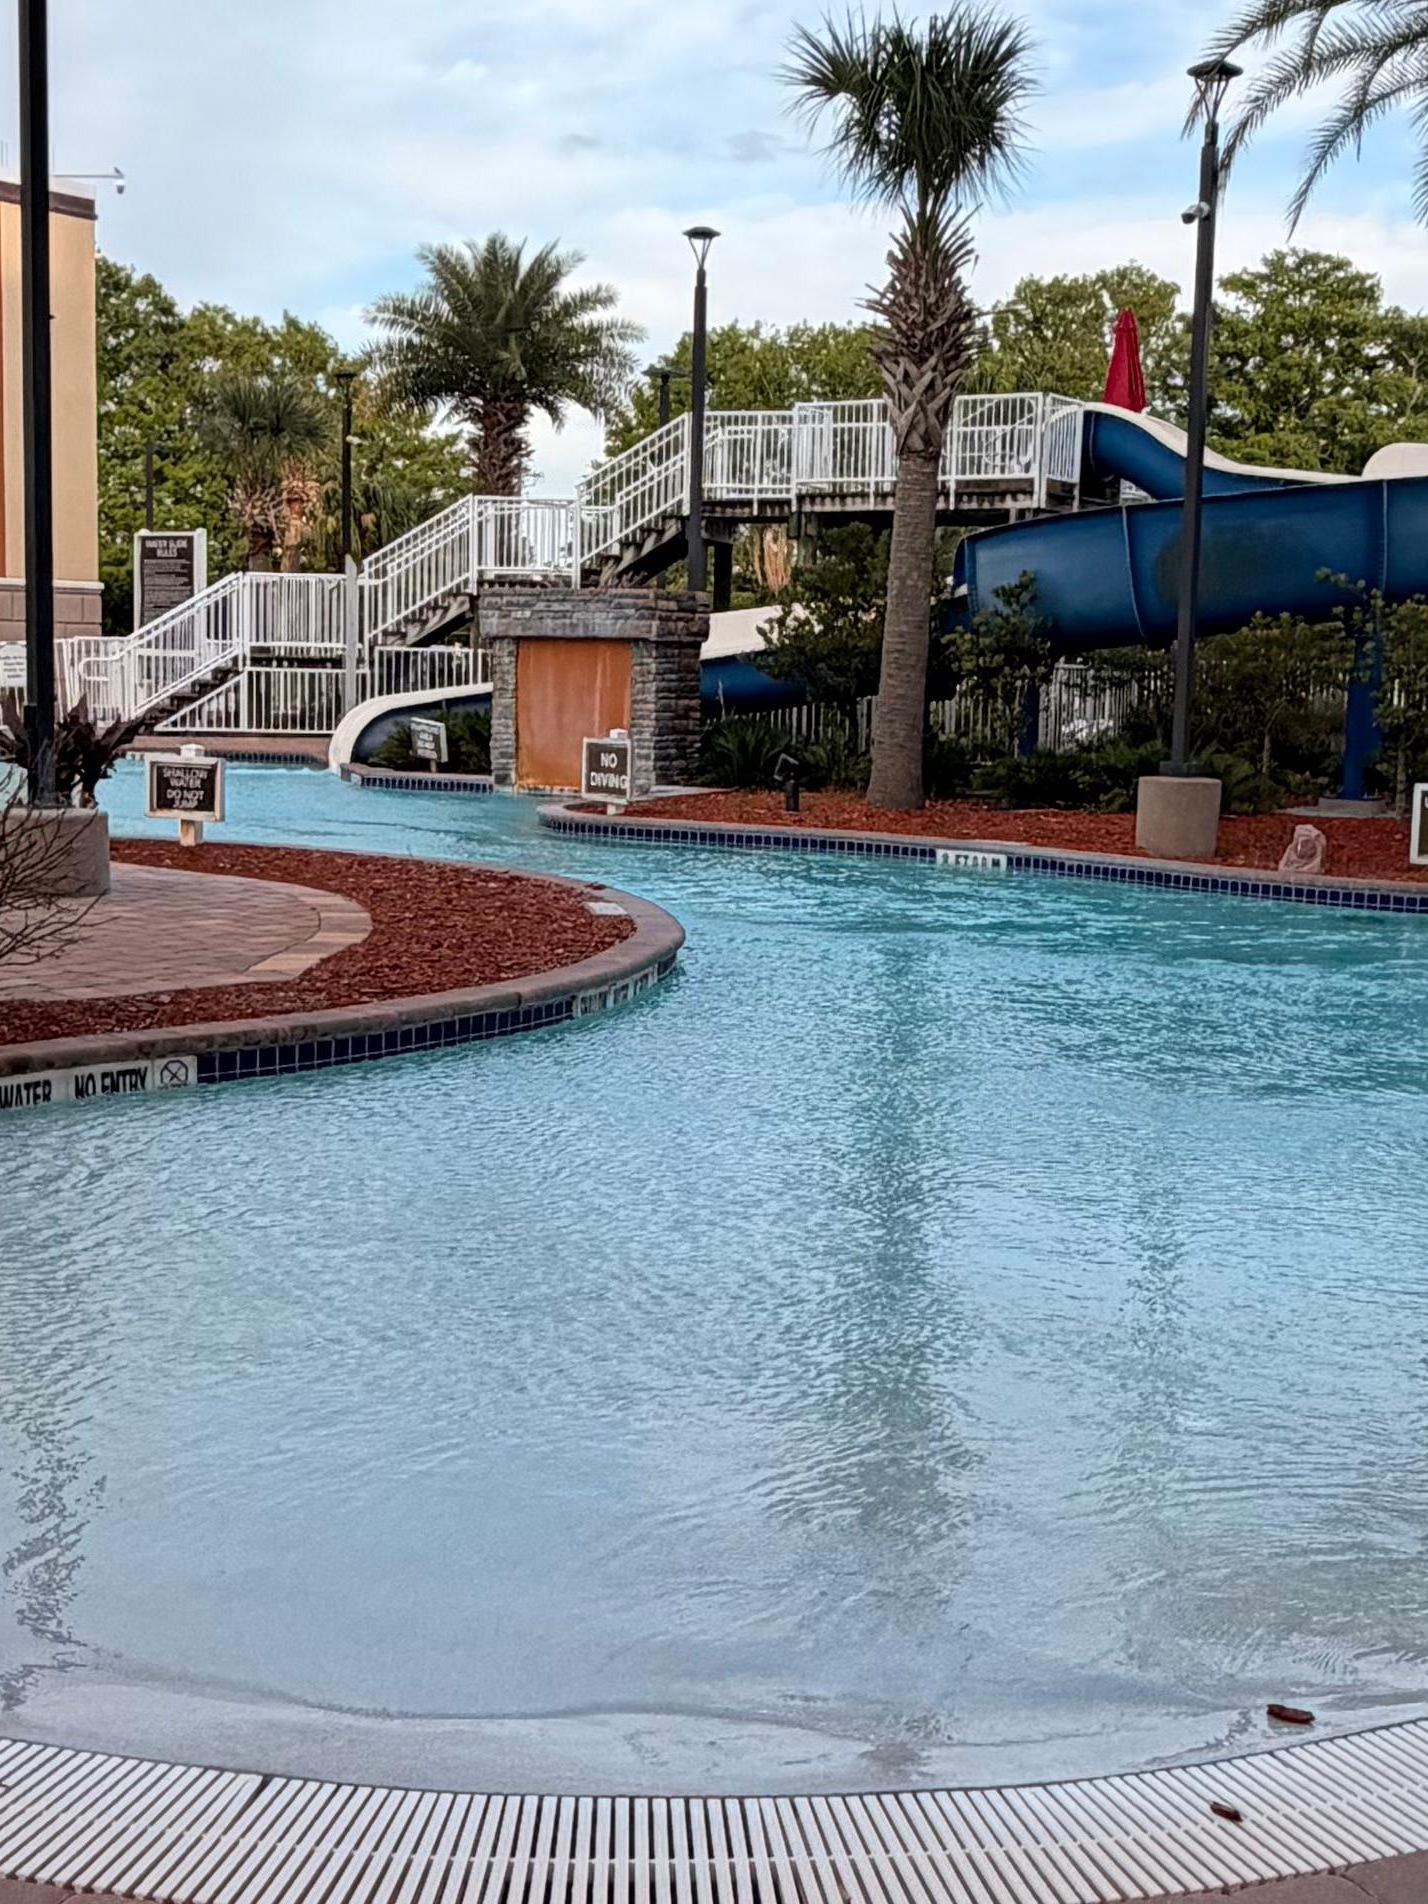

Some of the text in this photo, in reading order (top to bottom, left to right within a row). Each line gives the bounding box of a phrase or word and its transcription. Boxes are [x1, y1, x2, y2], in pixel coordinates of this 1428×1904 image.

[600, 752, 618, 768] NO
[590, 771, 629, 789] DIVING
[166, 789, 204, 800] DO NOT
[74, 1067, 148, 1099] NO ENTRY
